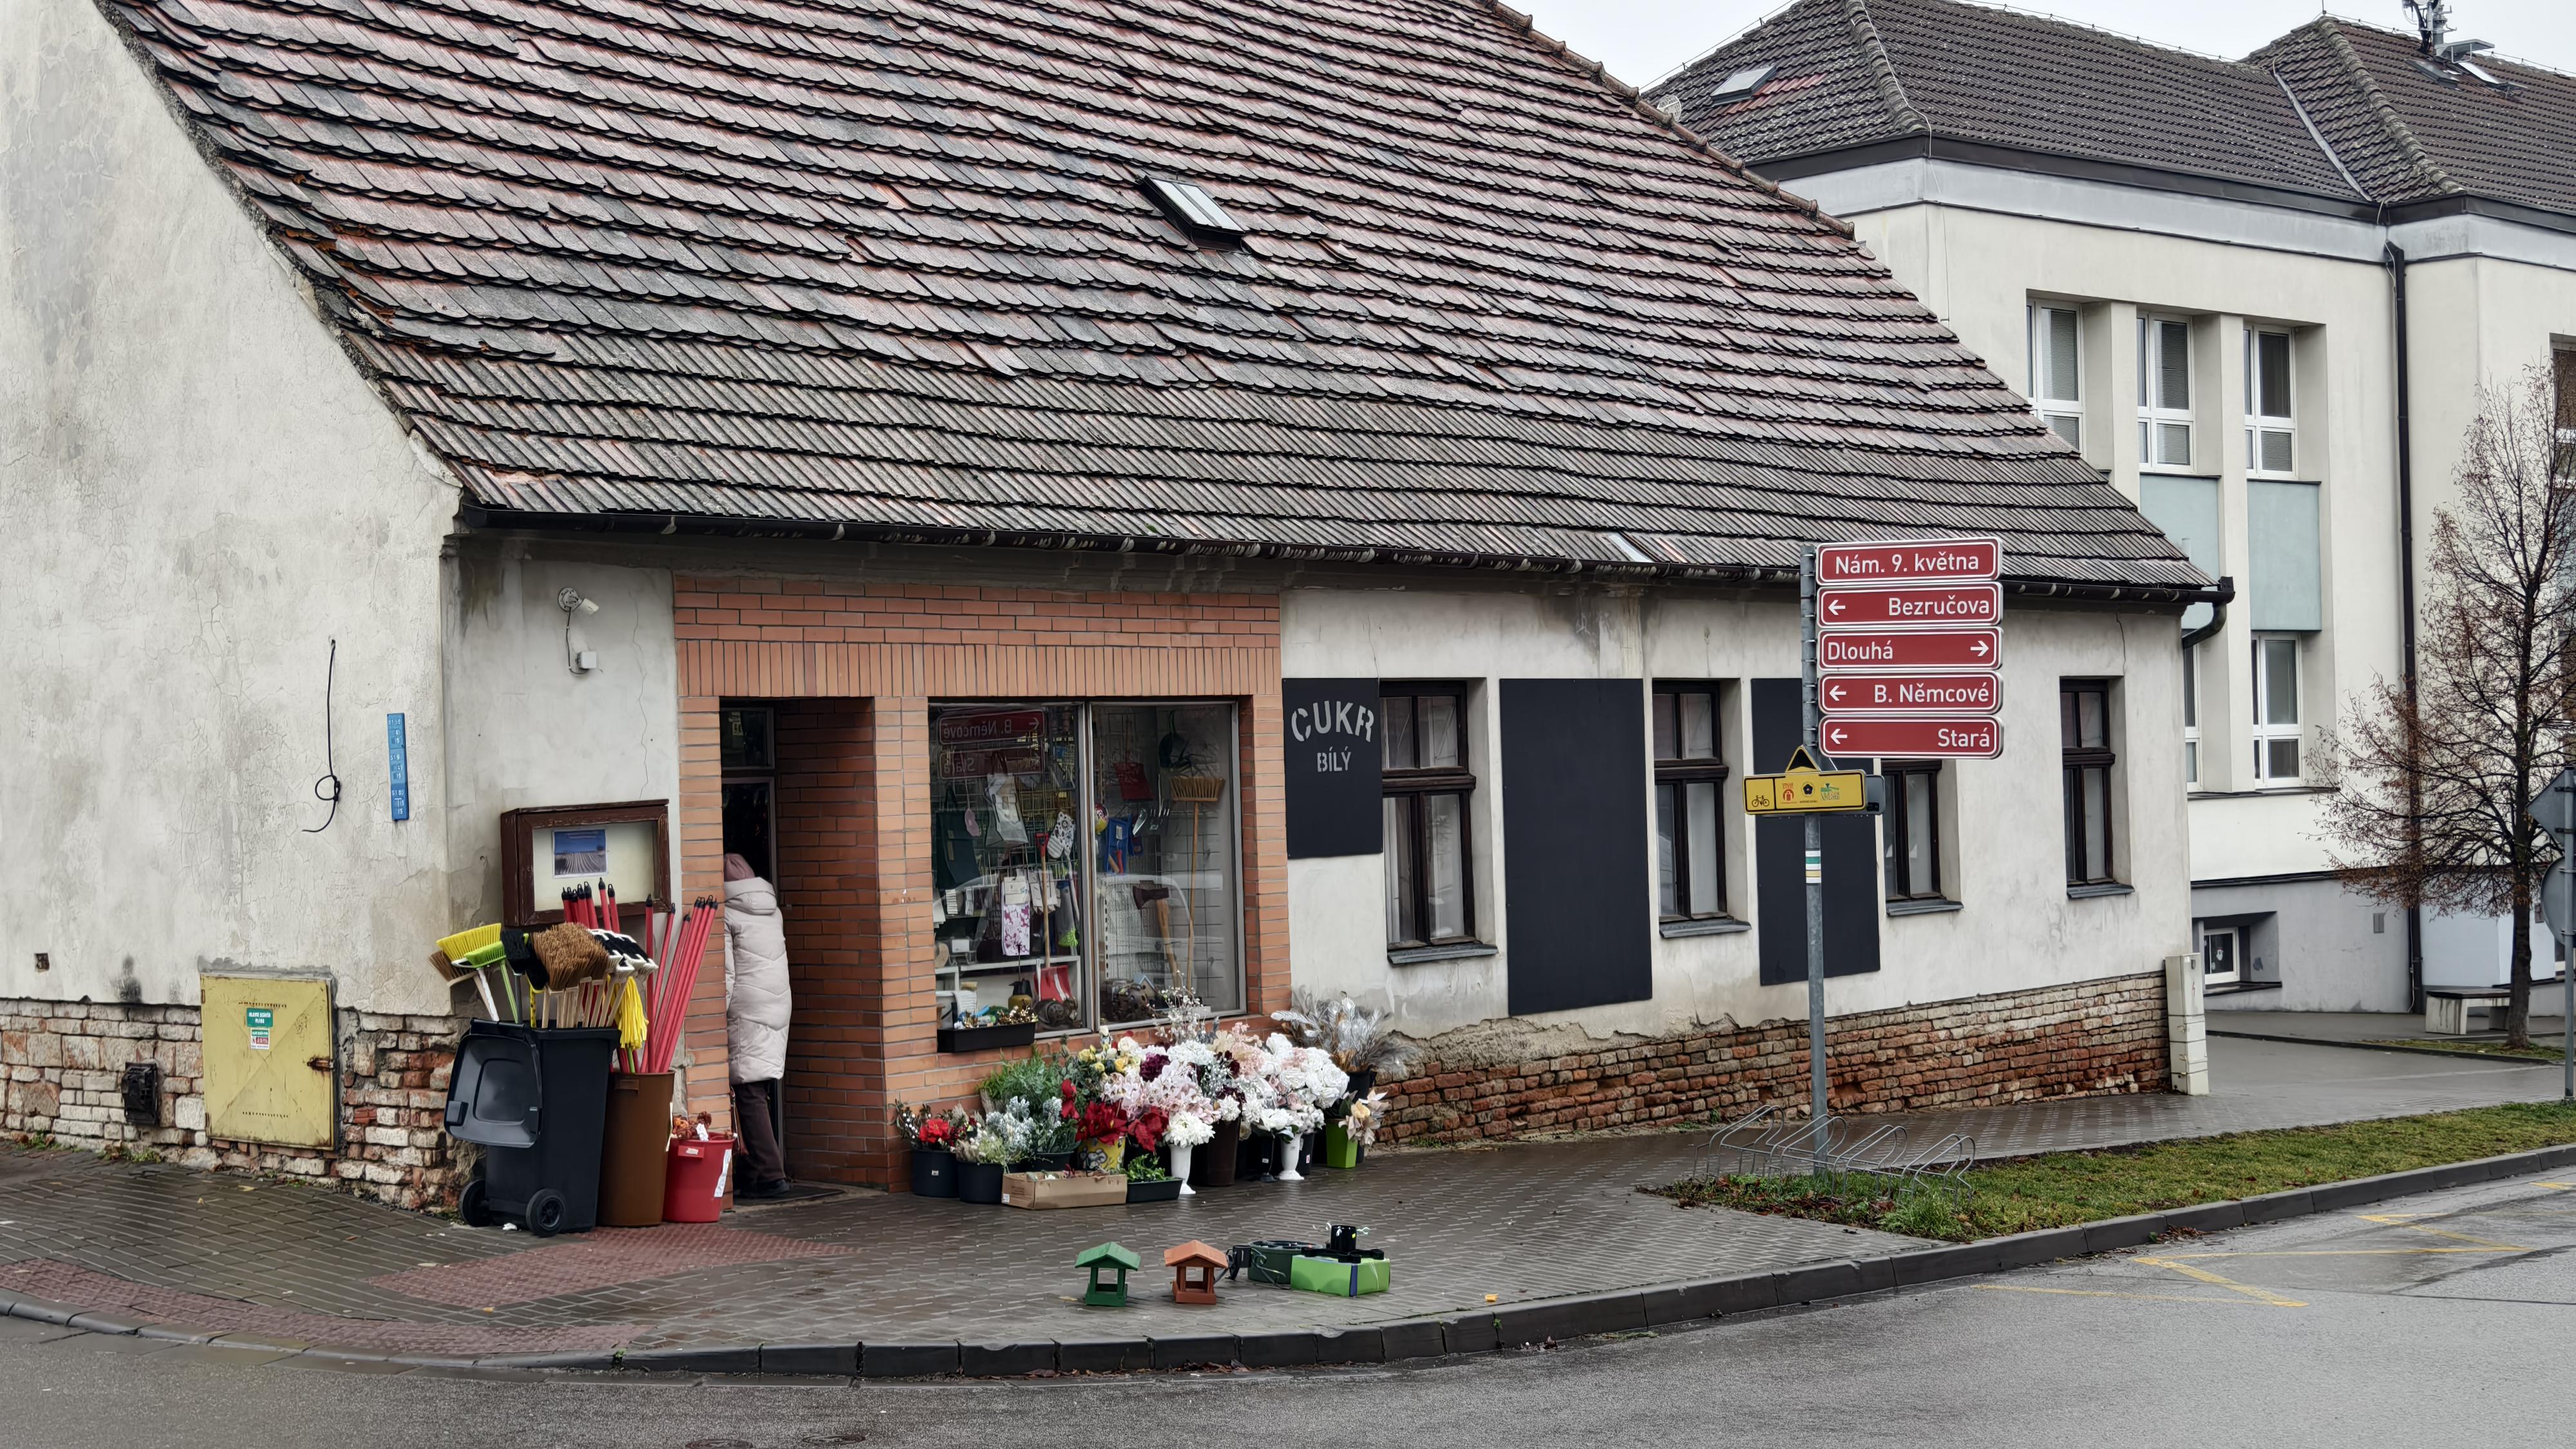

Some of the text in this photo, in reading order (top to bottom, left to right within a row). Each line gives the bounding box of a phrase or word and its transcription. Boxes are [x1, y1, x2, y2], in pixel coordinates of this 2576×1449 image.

[1835, 551, 1979, 574] Nám. 9. května
[1888, 594, 1990, 616] Bezručova
[1828, 639, 1894, 661] Dlouhá
[1873, 681, 1989, 703] B. Němcové
[1291, 700, 1374, 743] CUKR
[1937, 727, 1990, 748] Stará
[1317, 746, 1352, 772] BÍLÝ
